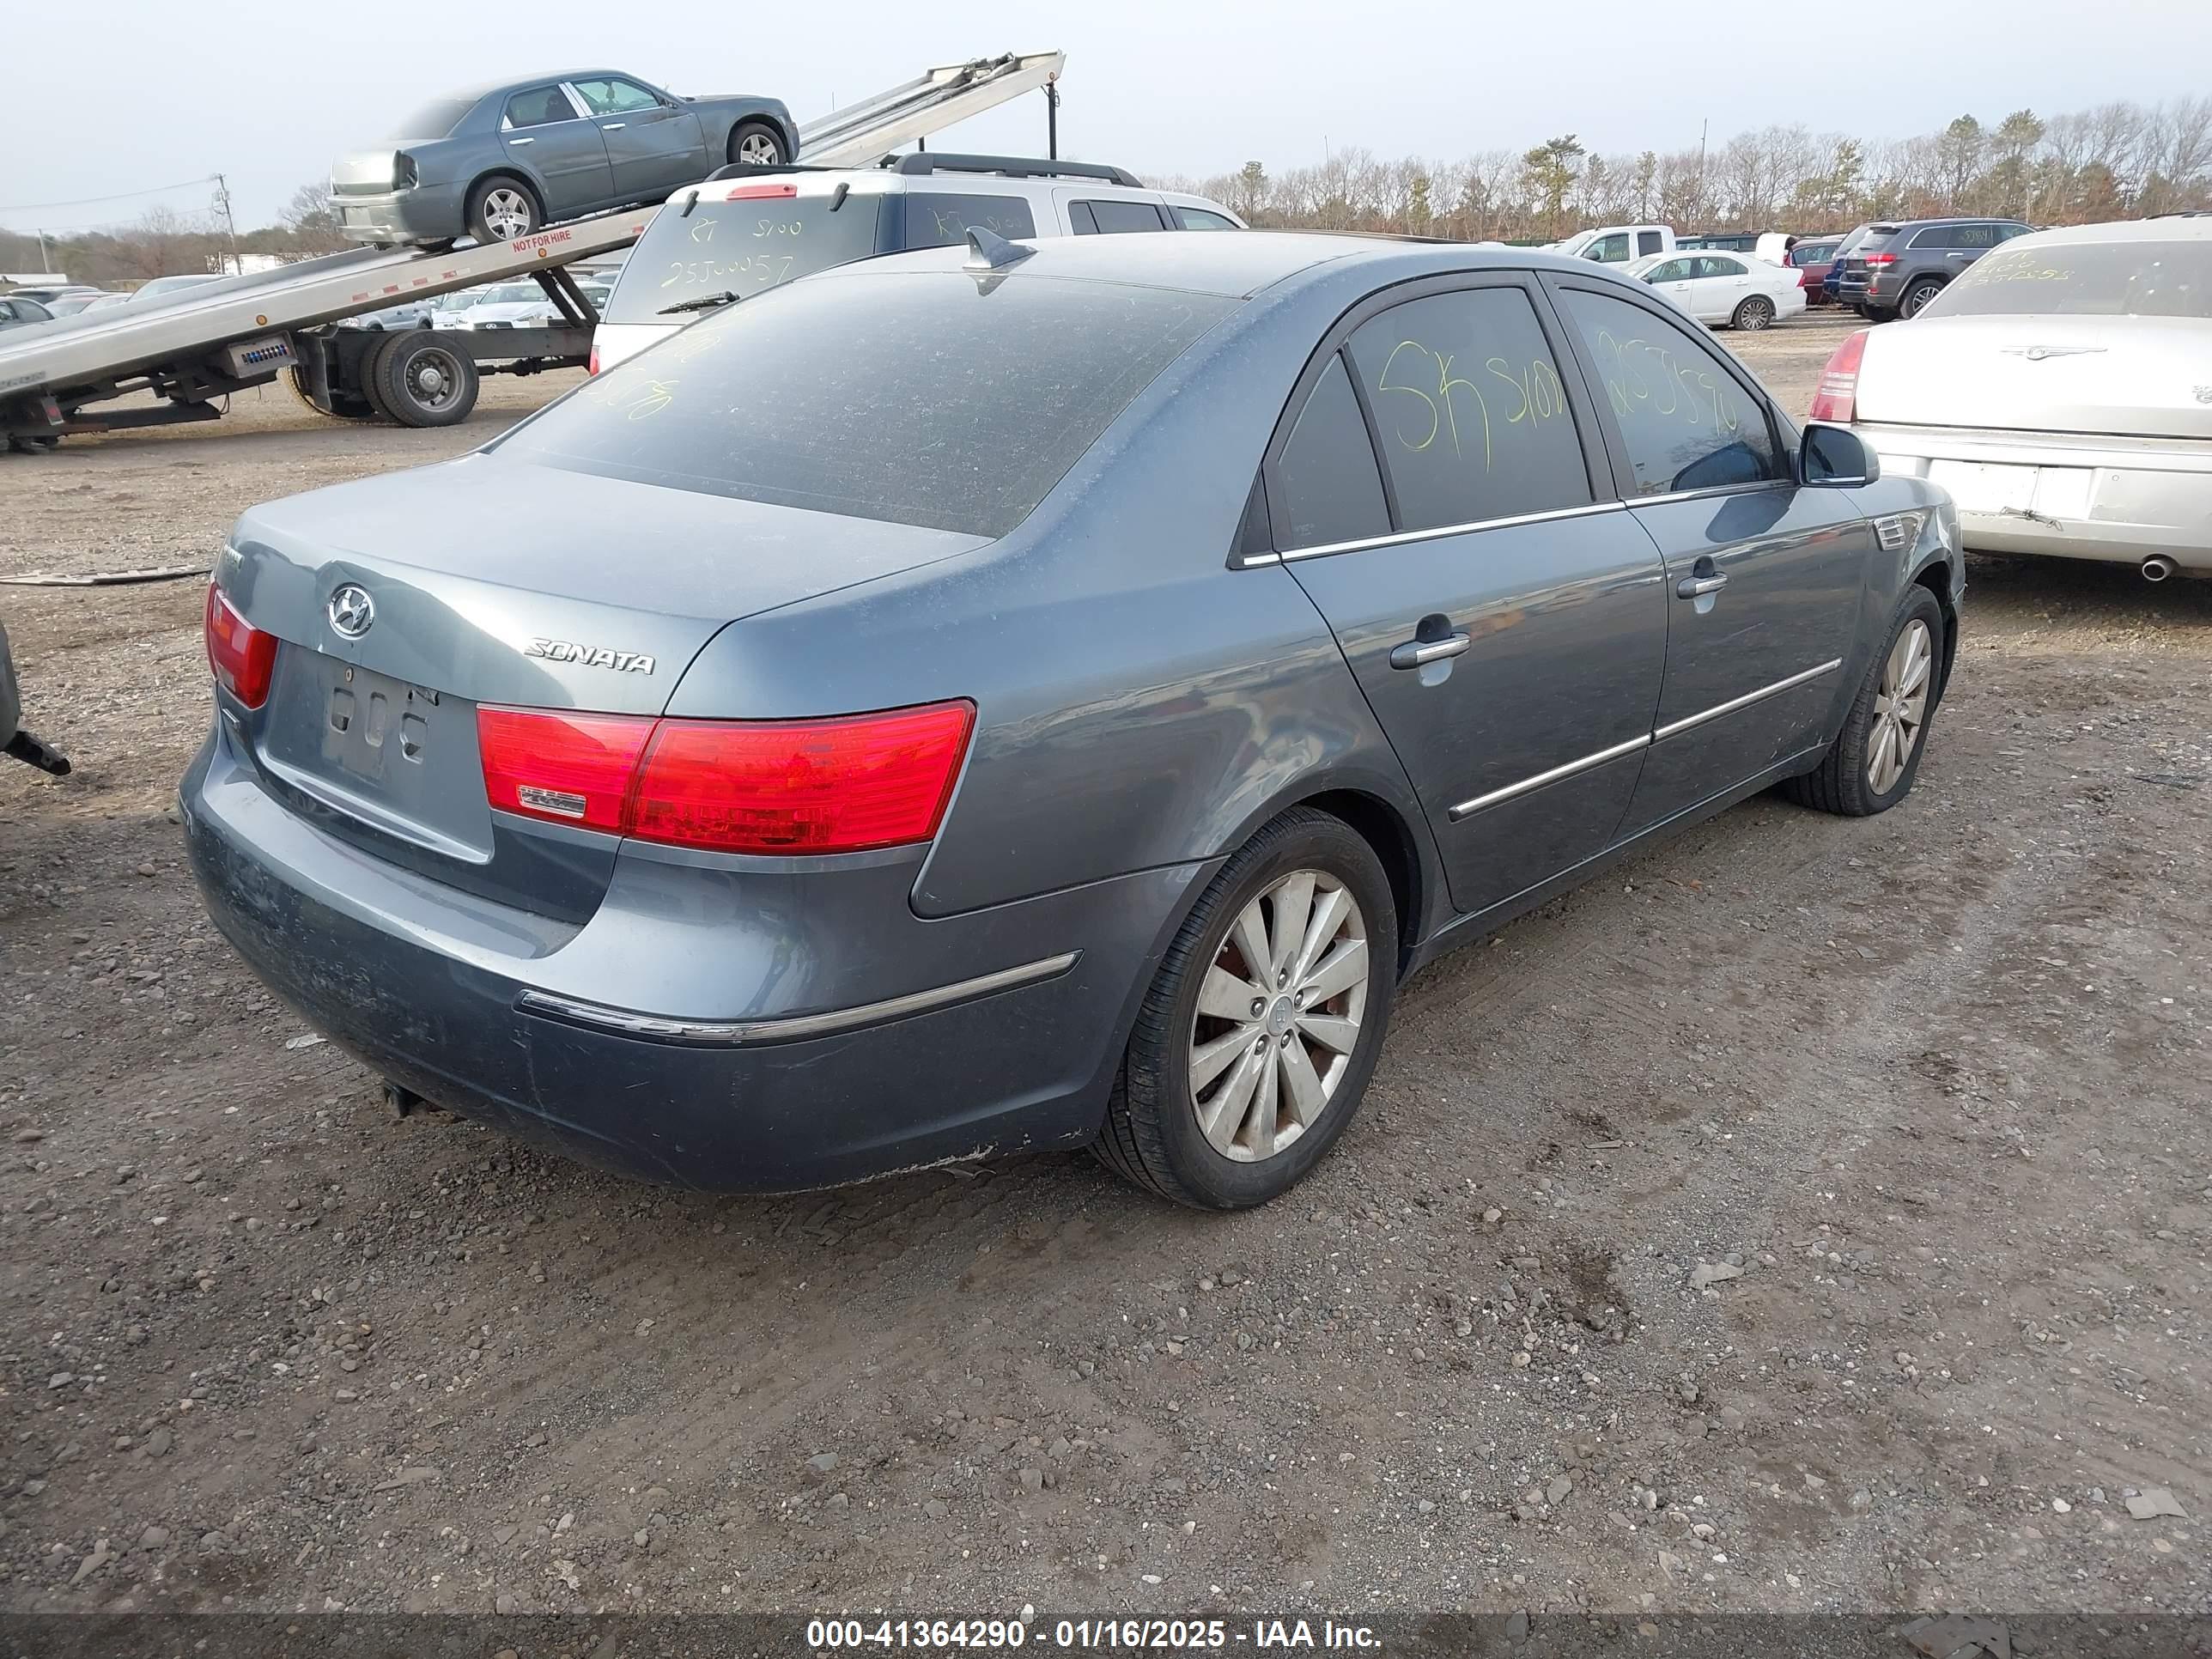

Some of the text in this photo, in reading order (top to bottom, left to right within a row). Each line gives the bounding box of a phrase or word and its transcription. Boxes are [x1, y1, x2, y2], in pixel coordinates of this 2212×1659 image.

[512, 229, 572, 252] NOT FOR HIRE
[523, 637, 657, 676] SONATA
